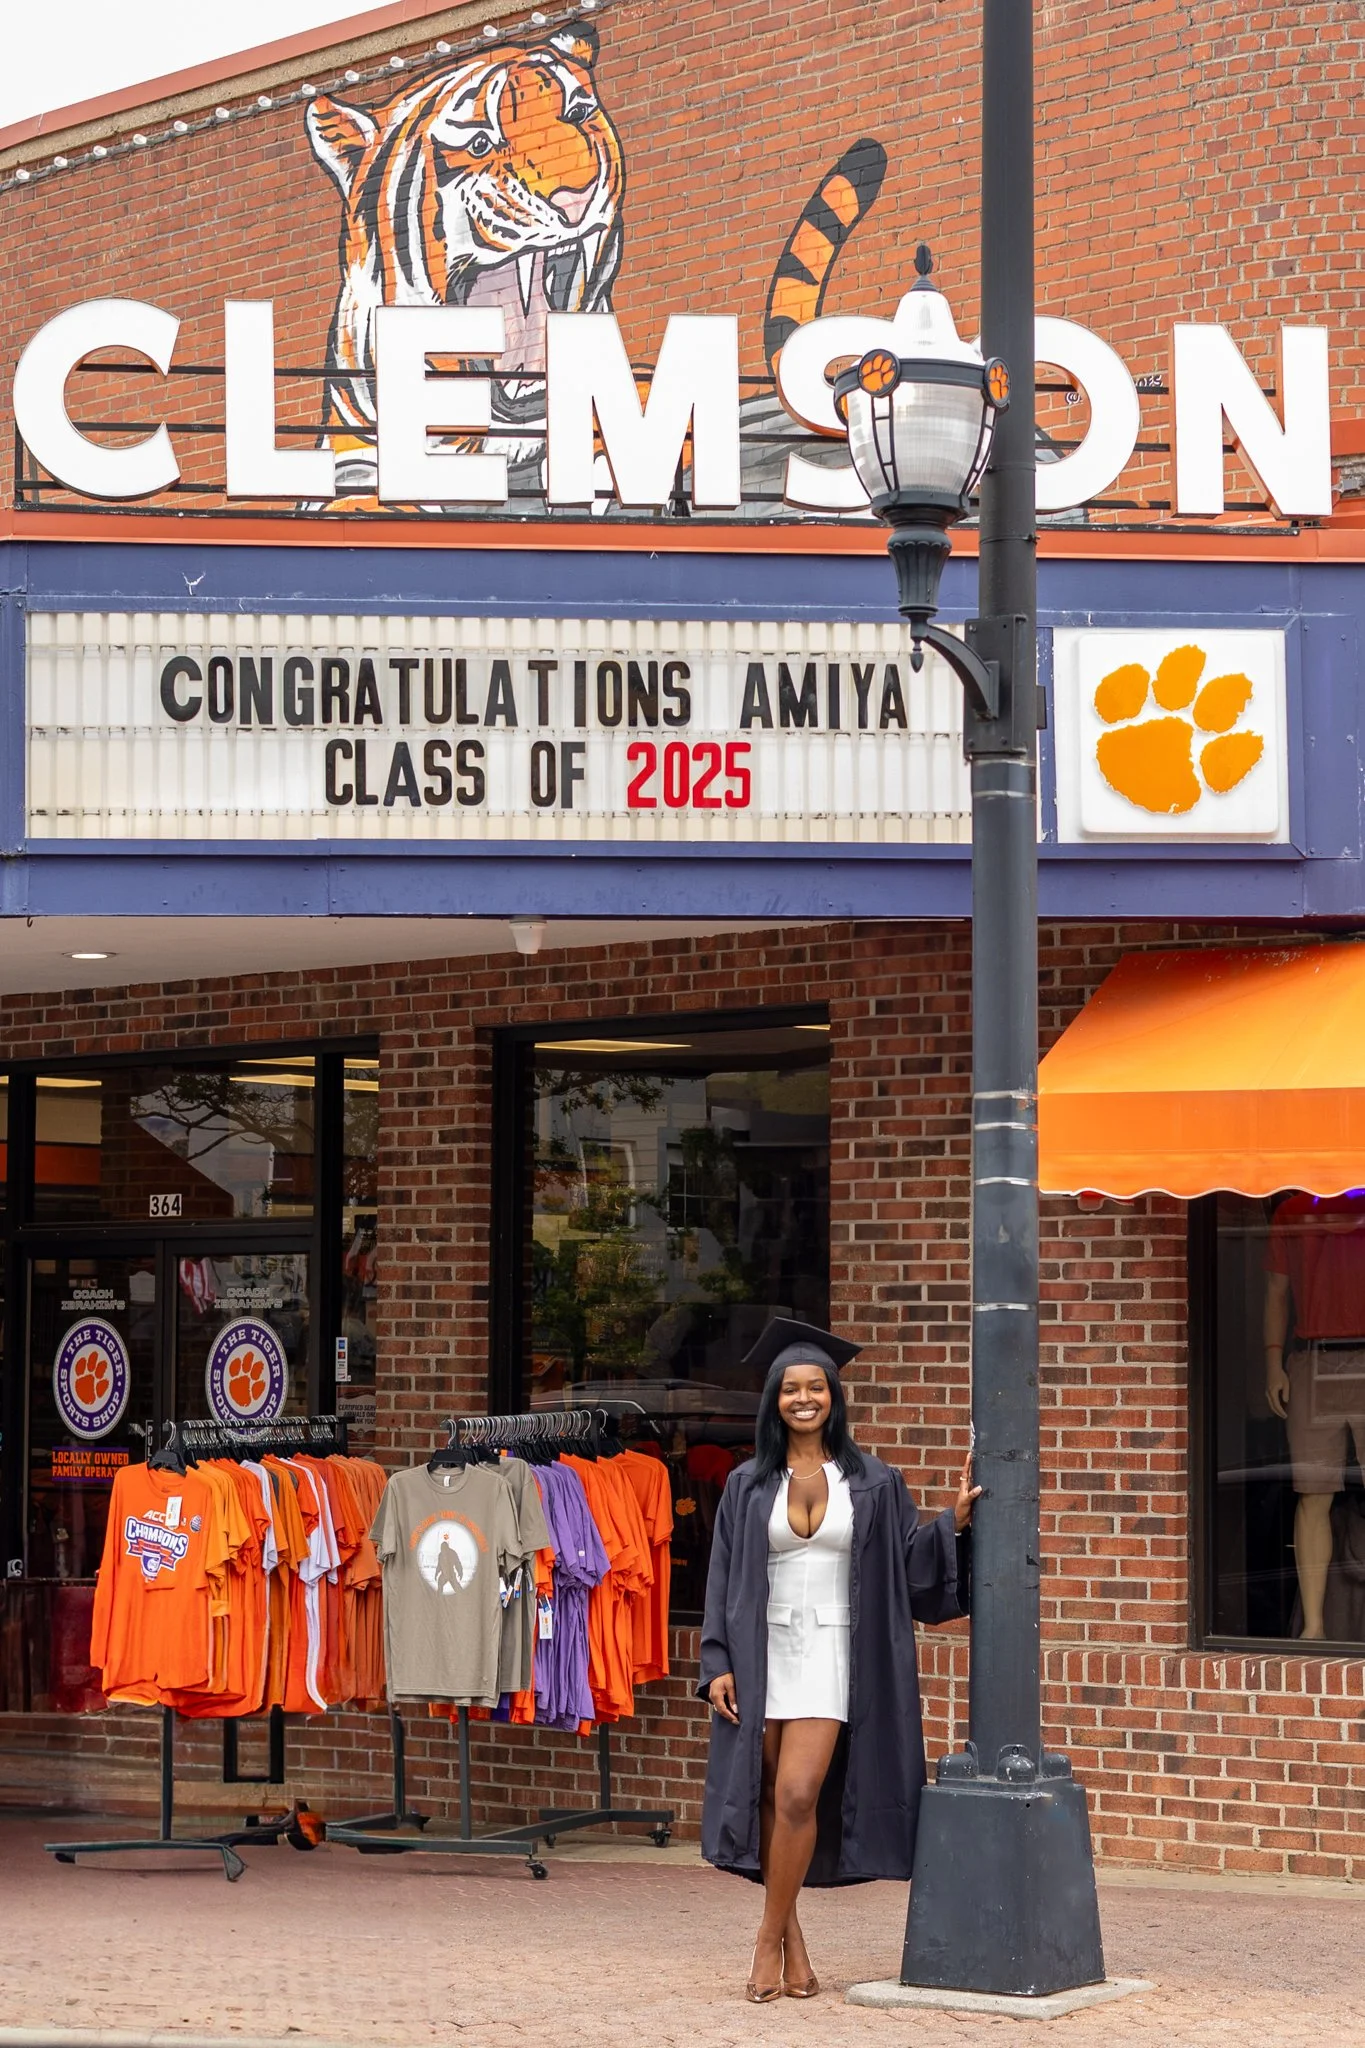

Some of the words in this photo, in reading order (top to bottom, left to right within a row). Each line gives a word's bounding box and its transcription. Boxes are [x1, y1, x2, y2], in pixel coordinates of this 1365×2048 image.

[12, 298, 1333, 518] CLEMSON
[160, 655, 692, 728] CONGRATULATIONS
[739, 661, 909, 730] AMIYA
[324, 738, 486, 808] CLASS
[530, 740, 586, 810] OF
[626, 741, 752, 810] 2025
[150, 1194, 182, 1217] 364
[61, 1299, 126, 1311] IBRAHIM'S
[72, 1289, 114, 1300] COACH
[214, 1298, 284, 1309] IBRAHIM'S
[226, 1287, 271, 1298] COACH
[67, 1329, 92, 1355] THE
[95, 1329, 123, 1377] TIGER
[220, 1329, 247, 1355] THE
[250, 1329, 281, 1378] TIGER
[60, 1368, 90, 1428] SPORTS
[92, 1391, 121, 1428] SHOP
[213, 1369, 238, 1421] SPORT
[52, 1451, 92, 1464] LOCALLY
[94, 1452, 129, 1465] OWNED
[52, 1466, 83, 1477] FAMILY
[85, 1467, 117, 1479] OPERAT
